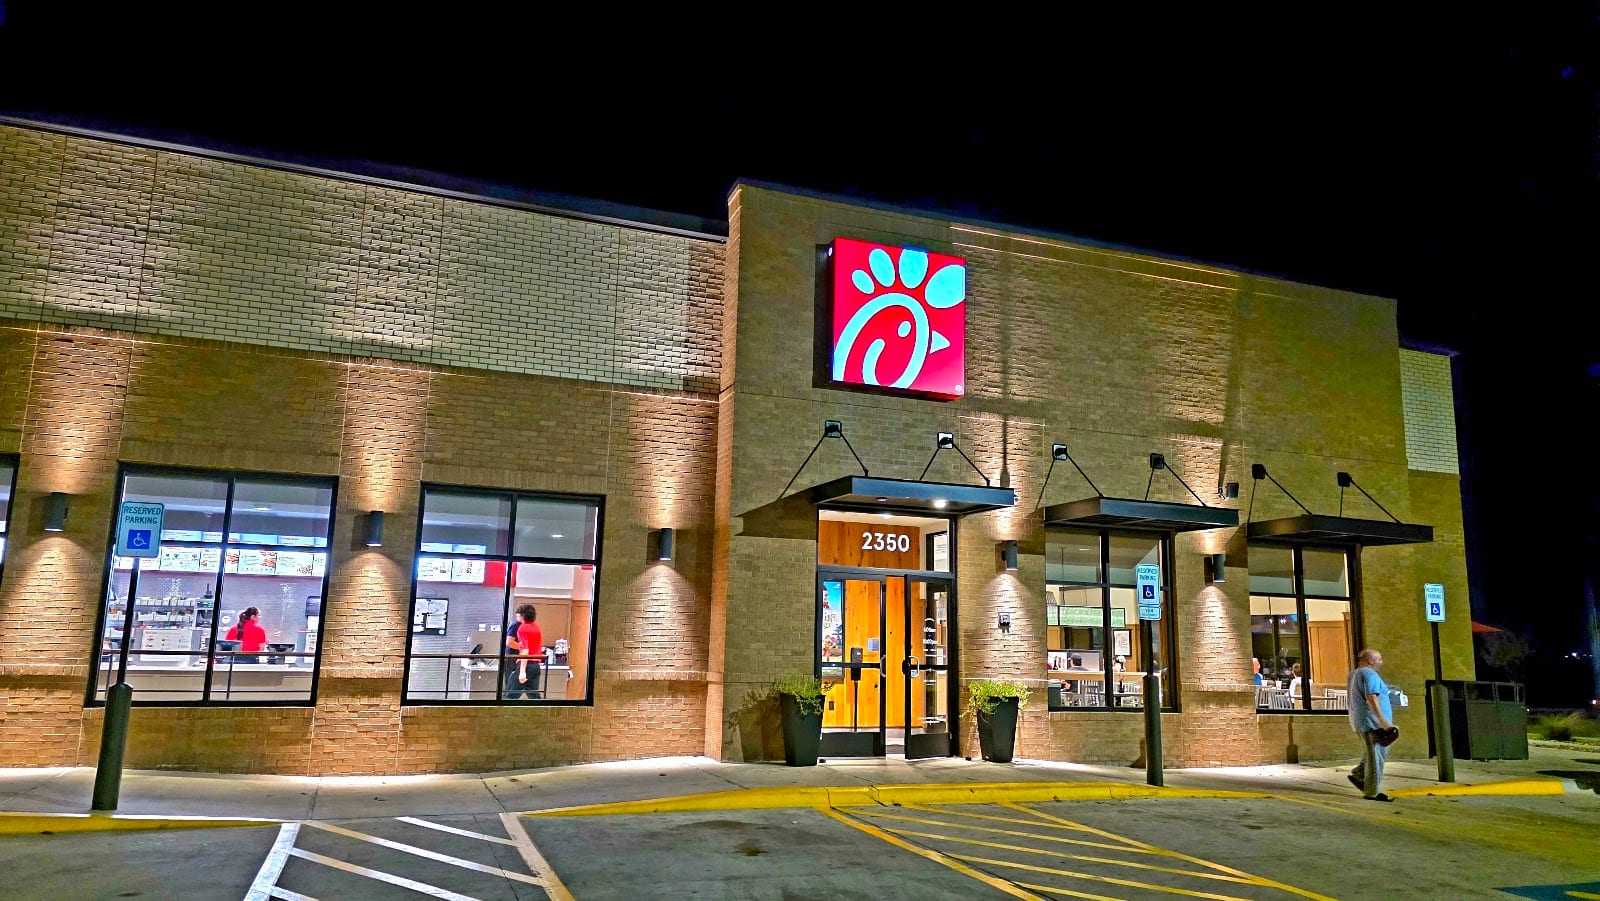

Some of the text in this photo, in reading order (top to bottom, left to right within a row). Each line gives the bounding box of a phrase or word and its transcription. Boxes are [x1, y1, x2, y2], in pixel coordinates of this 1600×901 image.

[123, 505, 162, 515] RESERVED
[125, 515, 158, 525] PARKING
[861, 531, 910, 552] 2350
